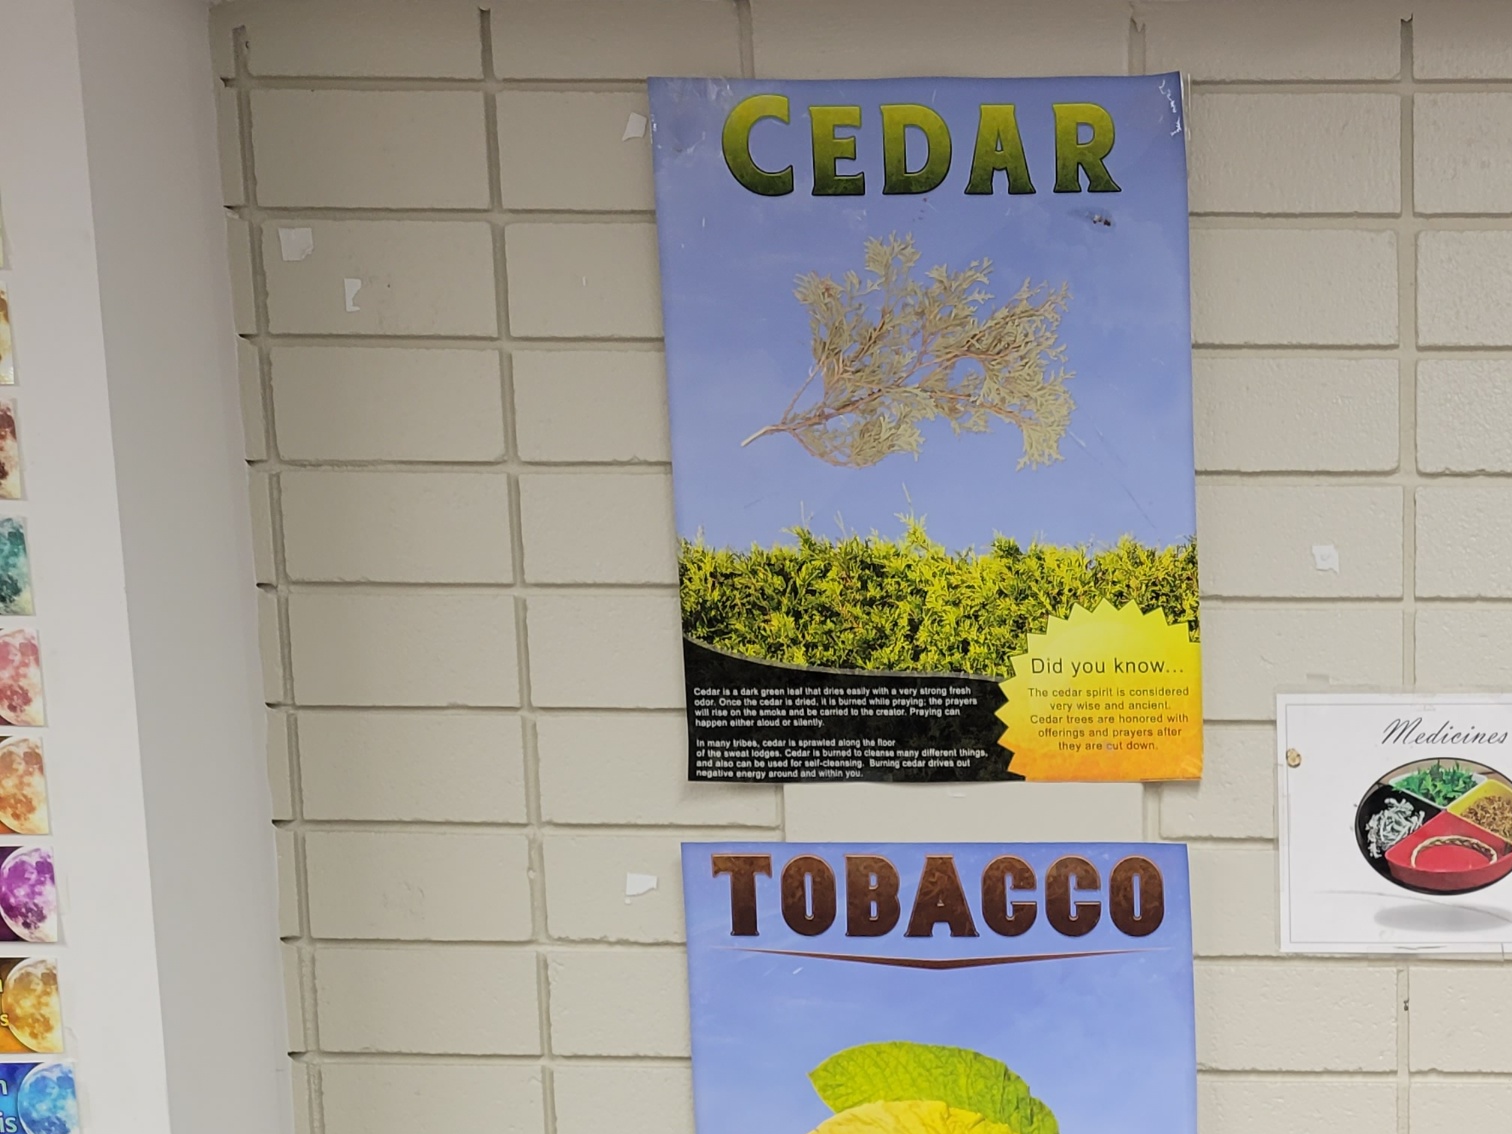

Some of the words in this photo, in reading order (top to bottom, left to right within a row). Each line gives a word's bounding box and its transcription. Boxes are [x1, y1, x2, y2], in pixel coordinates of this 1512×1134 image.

[722, 94, 1122, 197] CEDAR
[1031, 658, 1062, 674] Did
[1071, 661, 1105, 677] you
[1114, 657, 1184, 673] know...
[1028, 688, 1048, 697] The
[1052, 688, 1082, 697] cedar
[1086, 687, 1112, 699] spirit
[1116, 687, 1125, 696] is
[1129, 687, 1189, 696] considered
[1050, 703, 1072, 713] very
[1076, 701, 1100, 710] wise
[1104, 701, 1124, 710] and
[1128, 701, 1171, 710] ancient.
[1030, 715, 1063, 724] Cedar
[1066, 714, 1093, 723] trees
[1118, 714, 1162, 723] honored
[1166, 714, 1189, 723] with
[1038, 728, 1085, 740] offerings
[1088, 728, 1108, 737] and
[1112, 729, 1153, 739] prayers
[1156, 727, 1182, 736] after
[1382, 717, 1508, 745] Medicines
[1058, 741, 1081, 753] they
[1106, 741, 1122, 750] cut
[1126, 741, 1158, 750] down.
[696, 769, 733, 779] negative
[735, 770, 766, 779] energy
[768, 769, 798, 777] around
[800, 769, 816, 777] and
[818, 769, 843, 777] within
[845, 770, 864, 779] you.
[711, 853, 1165, 937] TOBACCO
